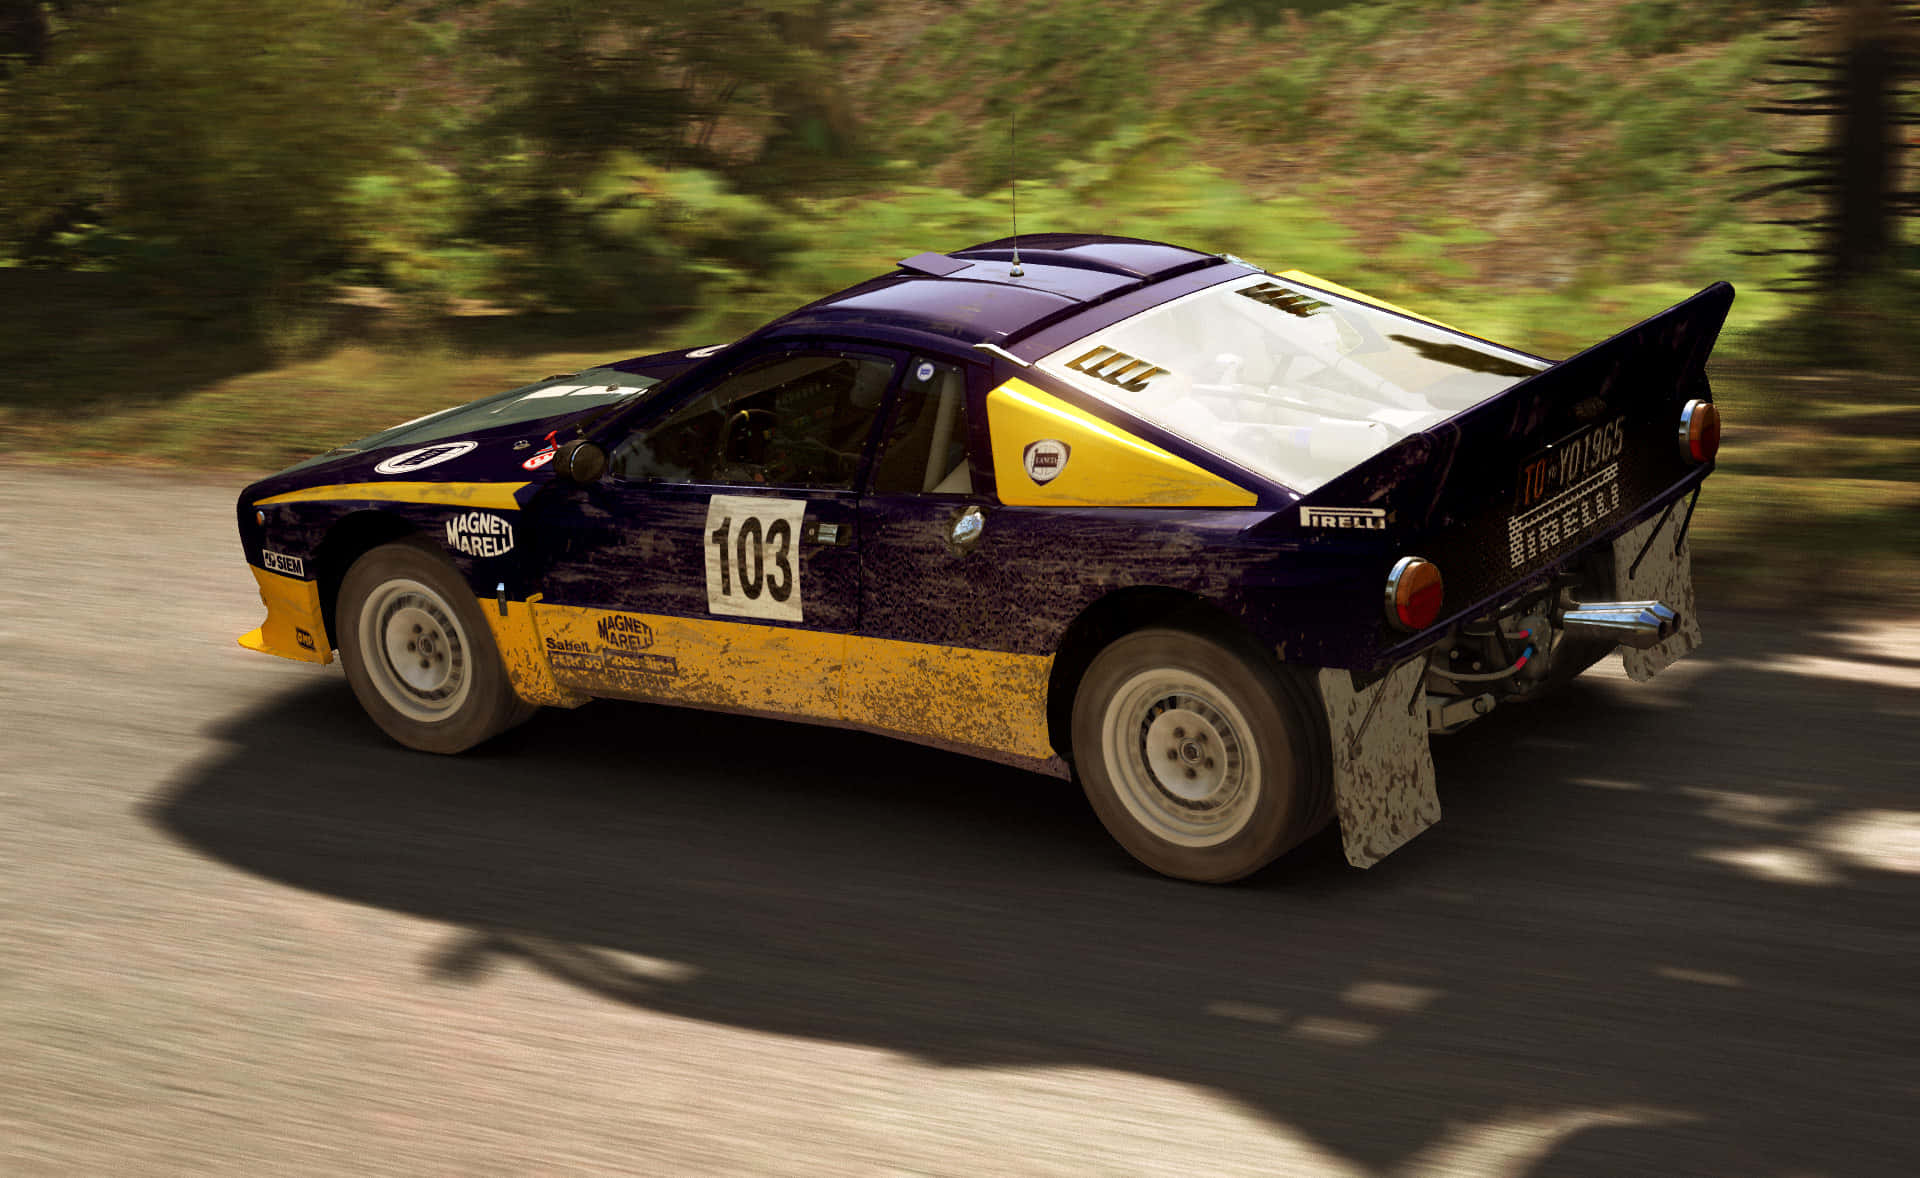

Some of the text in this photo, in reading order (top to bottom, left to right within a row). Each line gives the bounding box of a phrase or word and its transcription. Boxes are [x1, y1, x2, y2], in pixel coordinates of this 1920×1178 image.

[446, 511, 514, 541] MAGNETI
[1299, 506, 1386, 529] PIRELLI
[1506, 462, 1620, 568] PIRELLI
[446, 532, 514, 558] MARELLI
[276, 555, 303, 574] SIEM
[711, 516, 793, 602] 103
[597, 615, 654, 637] MAGNETI
